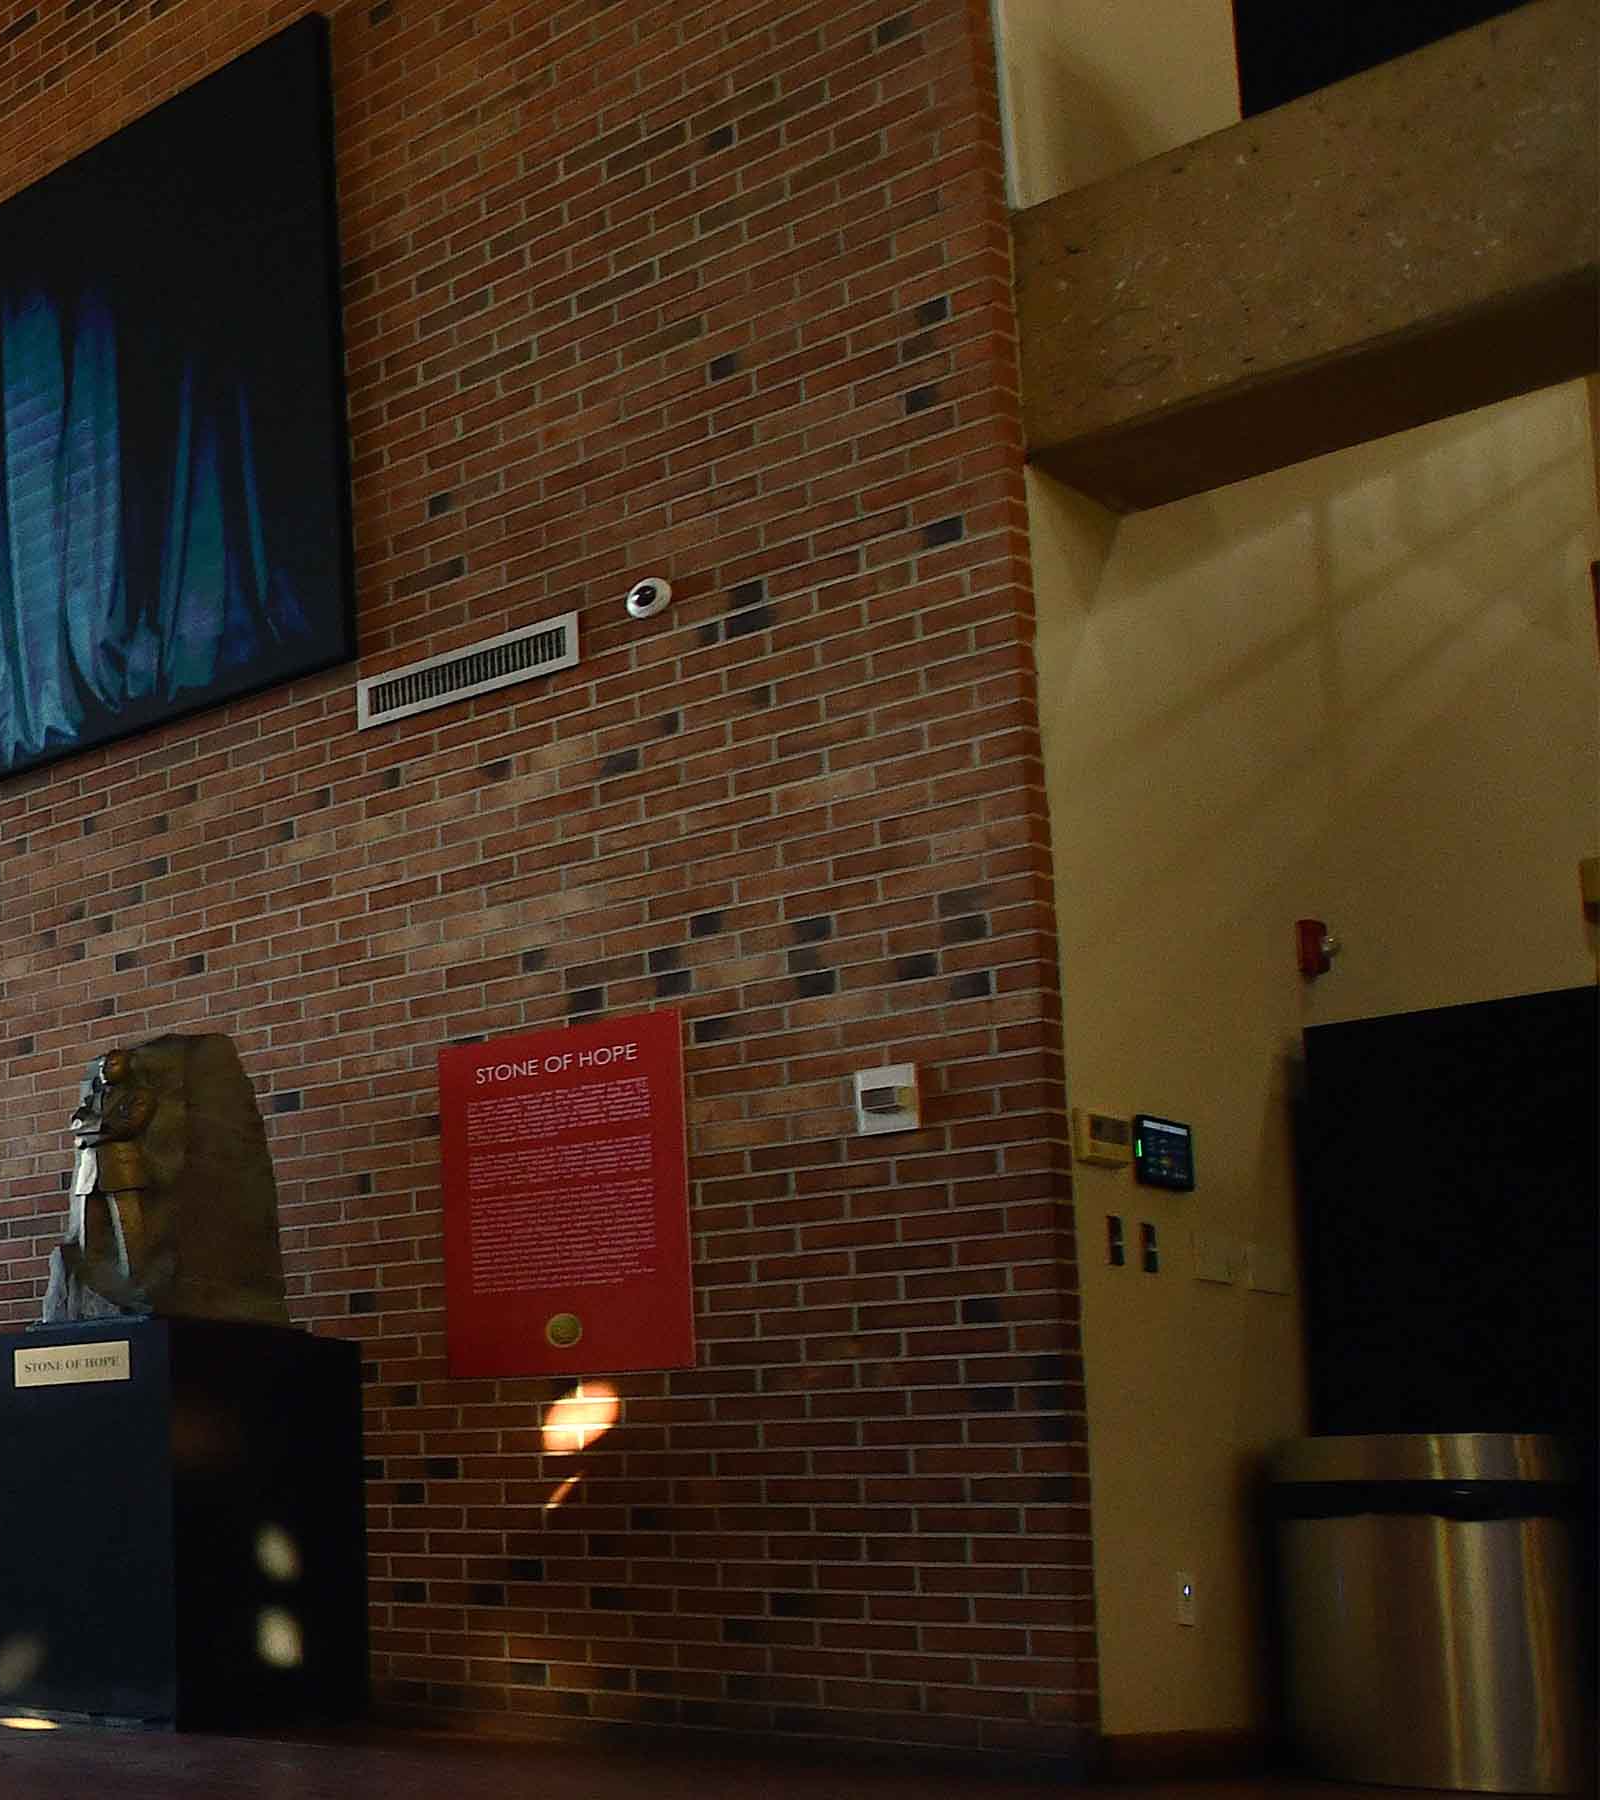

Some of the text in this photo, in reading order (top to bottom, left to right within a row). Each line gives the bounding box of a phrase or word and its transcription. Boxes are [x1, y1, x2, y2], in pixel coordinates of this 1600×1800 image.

[476, 1043, 638, 1084] STONE OF HOPE
[24, 1355, 121, 1373] STONE OF HOPE
